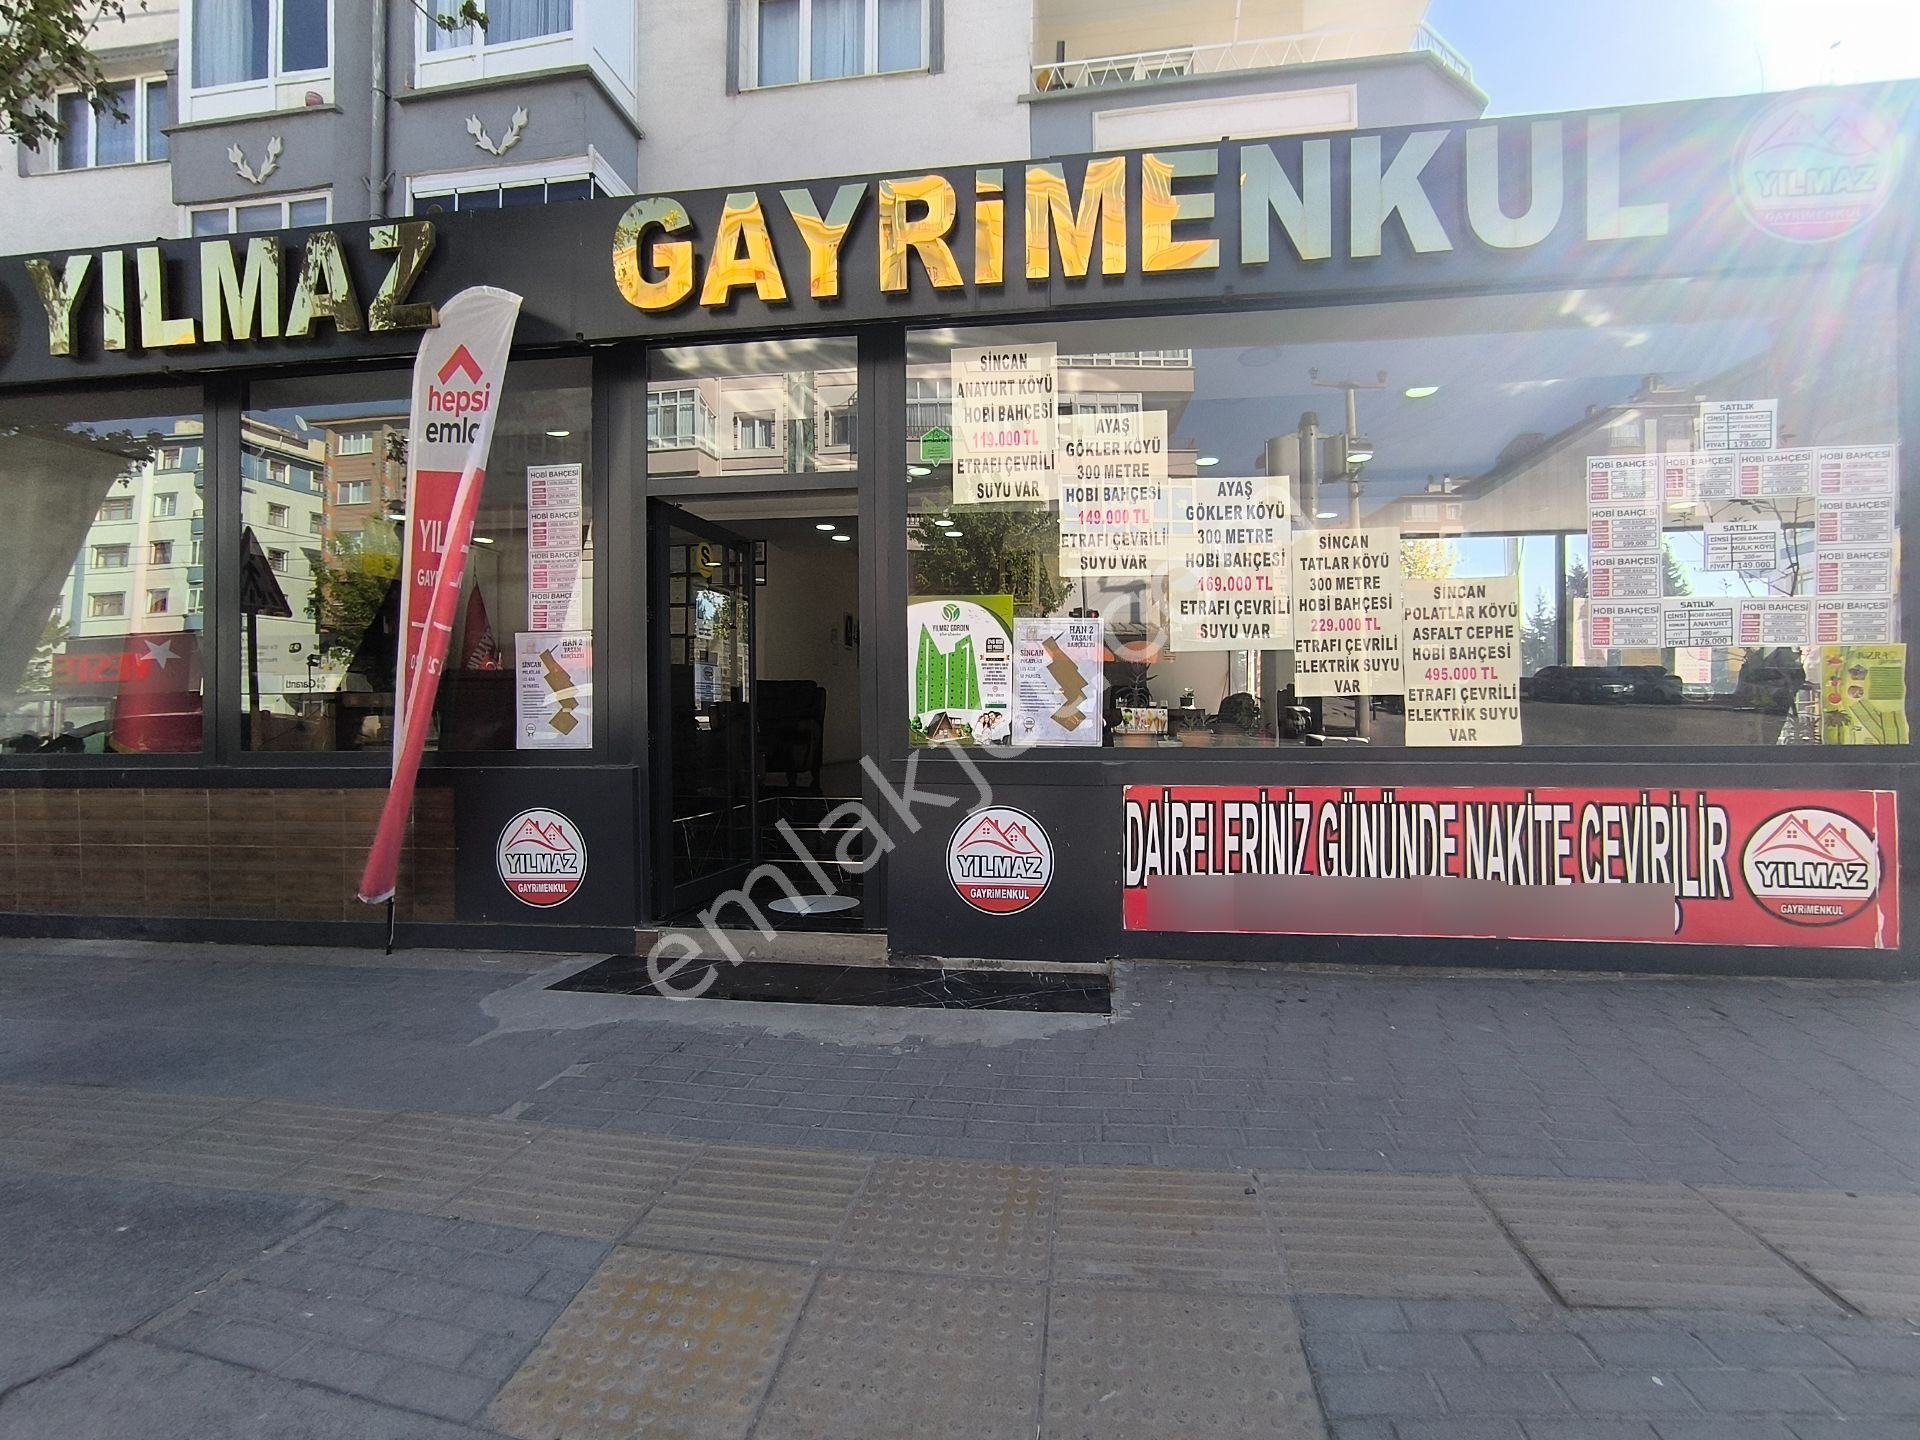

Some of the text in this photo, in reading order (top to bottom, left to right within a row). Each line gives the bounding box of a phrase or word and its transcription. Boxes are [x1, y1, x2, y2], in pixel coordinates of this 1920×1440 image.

[1756, 164, 1878, 198] YILMAZ
[24, 220, 438, 356] YILMAZ
[981, 352, 1027, 371] SİNCAN
[958, 374, 1052, 398] ANAYURT KÖYÜ
[428, 383, 491, 417] hepsi
[965, 399, 1052, 424] HOBİ BAHÇESİ
[1097, 418, 1129, 436] AYAŞ
[973, 430, 1038, 448] 119.000 TL
[1066, 437, 1160, 457] GÖKLER KÖYÜ
[958, 450, 1054, 475] ETRAFI ÇEVRİLİ
[1742, 453, 1810, 463] HOBİ BAHÇESİ
[1820, 451, 1890, 460] HOBİ BAHÇESİ
[1078, 463, 1149, 479] 300 METRE
[1591, 460, 1613, 469] HOBİ
[977, 481, 1039, 498] SUYU VAR
[1066, 482, 1161, 504] HOBİ BAHÇESİ
[1218, 481, 1252, 500] AYAŞ
[1186, 501, 1284, 520] GÖKLER KÖYÜ
[1592, 509, 1615, 517] HOBİ
[1820, 500, 1890, 510] HOBİ BAHÇESİ
[1078, 510, 1149, 524] 149.000 TL
[1062, 528, 1166, 550] ETRAFI ÇEVRİLİ
[1198, 529, 1272, 544] 300 METRE
[1319, 533, 1368, 549] SİNCAN
[1081, 555, 1147, 570] SUYU VAR
[1186, 548, 1285, 571] HOBİ BAHÇESİ
[1300, 553, 1389, 570] TATLAR KÖYÜ
[1592, 557, 1658, 566] HOBİ BAHÇESİ
[1819, 552, 1889, 560] HOBİ BAHÇESİ
[1198, 576, 1272, 591] 169.000 TL
[1310, 576, 1380, 590] 300 METRE
[1434, 583, 1486, 599] SİNCAN
[1180, 596, 1290, 618] ETRAFI ÇEVRİLİ
[1299, 593, 1392, 613] HOBİ BAHÇESİ
[1405, 602, 1517, 620] POLATLAR KÖYÜ
[1593, 606, 1659, 615] HOBİ BAHÇESİ
[1680, 600, 1715, 609] SATILIK
[1743, 603, 1808, 611] HOBİ BAHÇESİ
[1819, 601, 1888, 610] HOBİ BAHÇESİ
[1070, 626, 1094, 634] HAN 2
[1200, 624, 1270, 638] SUYU VAR
[1311, 618, 1380, 632] 229.000 TL
[1413, 625, 1513, 640] ASFALT CEPHE
[1020, 648, 1043, 656] SİNCAN
[1296, 635, 1398, 655] ETRAFI ÇEVRİLİ
[1413, 643, 1510, 662] HOBİ BAHÇESİ
[1295, 657, 1399, 673] ELEKTRİK SUYU
[1425, 667, 1497, 680] 495.000 TL
[1334, 680, 1360, 692] VAR
[1409, 684, 1516, 704] ETRAFI ÇEVRİLİ
[1408, 706, 1518, 721] ELEKTRİK SUYU
[1449, 729, 1477, 741] VAR
[1125, 788, 1313, 887] DAİRELERİNİZ
[1318, 788, 1459, 879] GÜNÜNDE
[1465, 789, 1572, 886] NAKİTE
[505, 853, 577, 874] YILMAZ
[957, 855, 1042, 879] YILMAZ
[1755, 861, 1869, 890] YILMAZ
